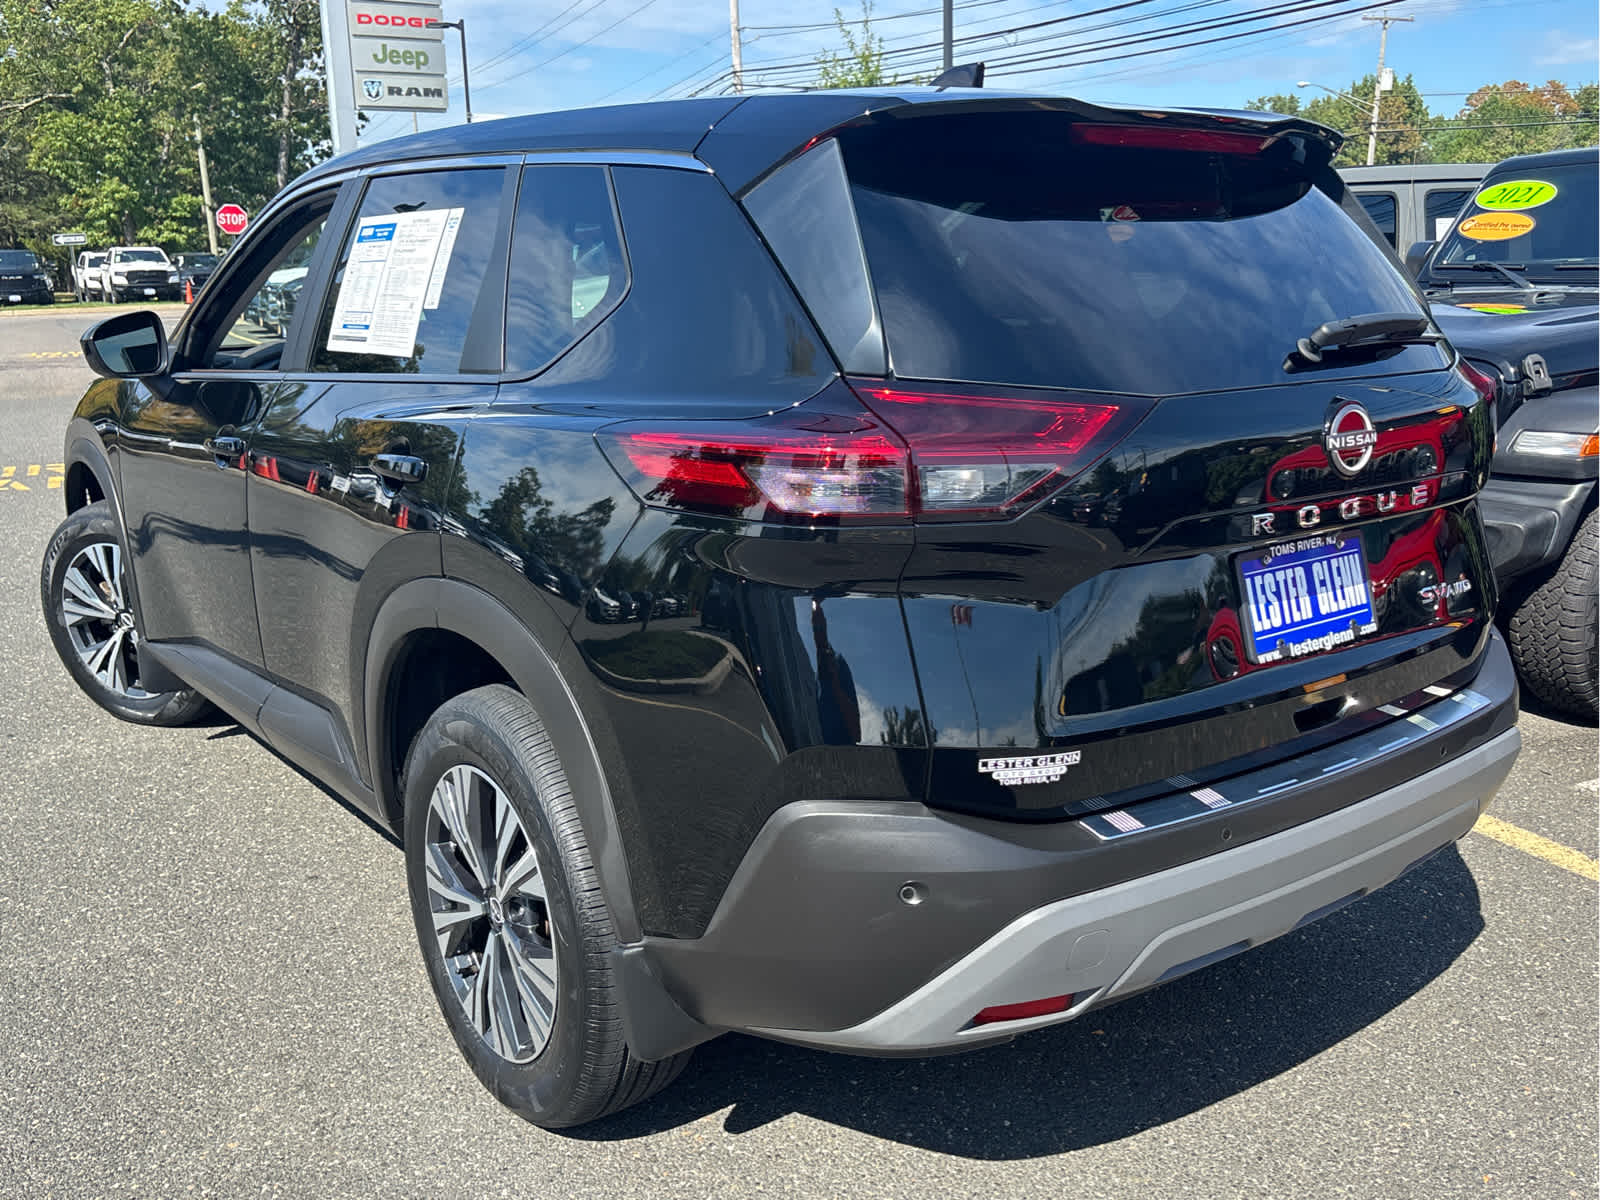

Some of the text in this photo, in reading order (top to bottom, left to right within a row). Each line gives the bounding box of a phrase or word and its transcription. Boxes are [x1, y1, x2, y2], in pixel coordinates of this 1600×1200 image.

[372, 43, 429, 70] Jeep
[387, 86, 443, 98] RAM
[1485, 186, 1545, 204] 2021
[219, 213, 245, 225] STOP
[1328, 432, 1377, 449] NISSAN
[1252, 484, 1428, 536] ROGUE
[1270, 544, 1296, 557] TOMS
[1326, 537, 1337, 545] NJ
[1245, 553, 1368, 632] LESTER GLENN
[1417, 582, 1446, 604] SV
[1257, 652, 1282, 664] www.
[1290, 629, 1354, 657] lesterglenn
[979, 753, 1079, 770] LESTER GLENN
[996, 766, 1065, 778] AUTO GROUP
[999, 778, 1022, 786] TOMS
